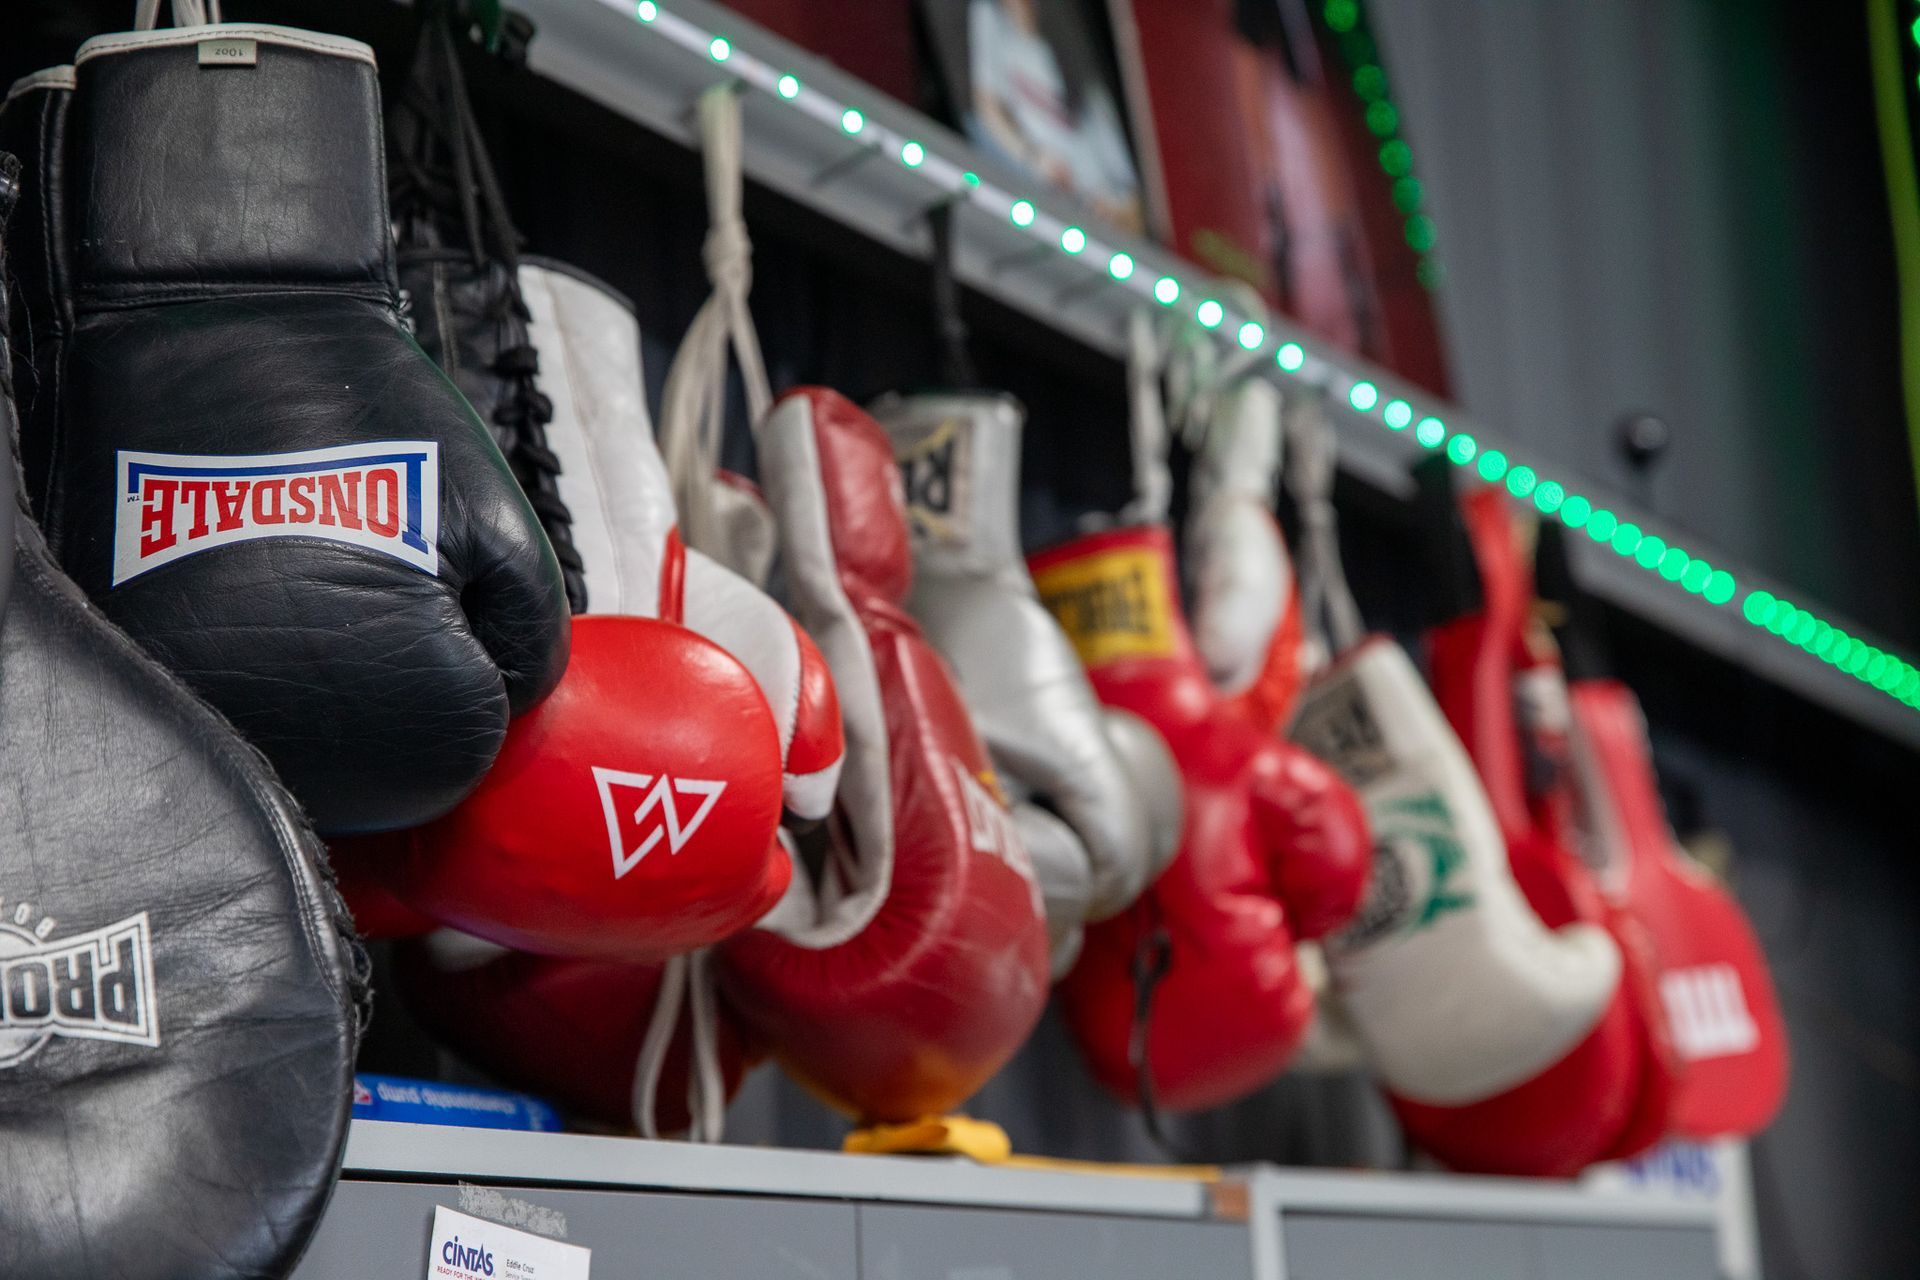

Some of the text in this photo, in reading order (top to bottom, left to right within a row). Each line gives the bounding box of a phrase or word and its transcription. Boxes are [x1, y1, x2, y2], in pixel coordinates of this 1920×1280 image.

[215, 48, 243, 56] 10oz
[127, 452, 430, 560] LONSDALE
[0, 936, 141, 1026] PRO
[506, 1259, 521, 1270] Eddie
